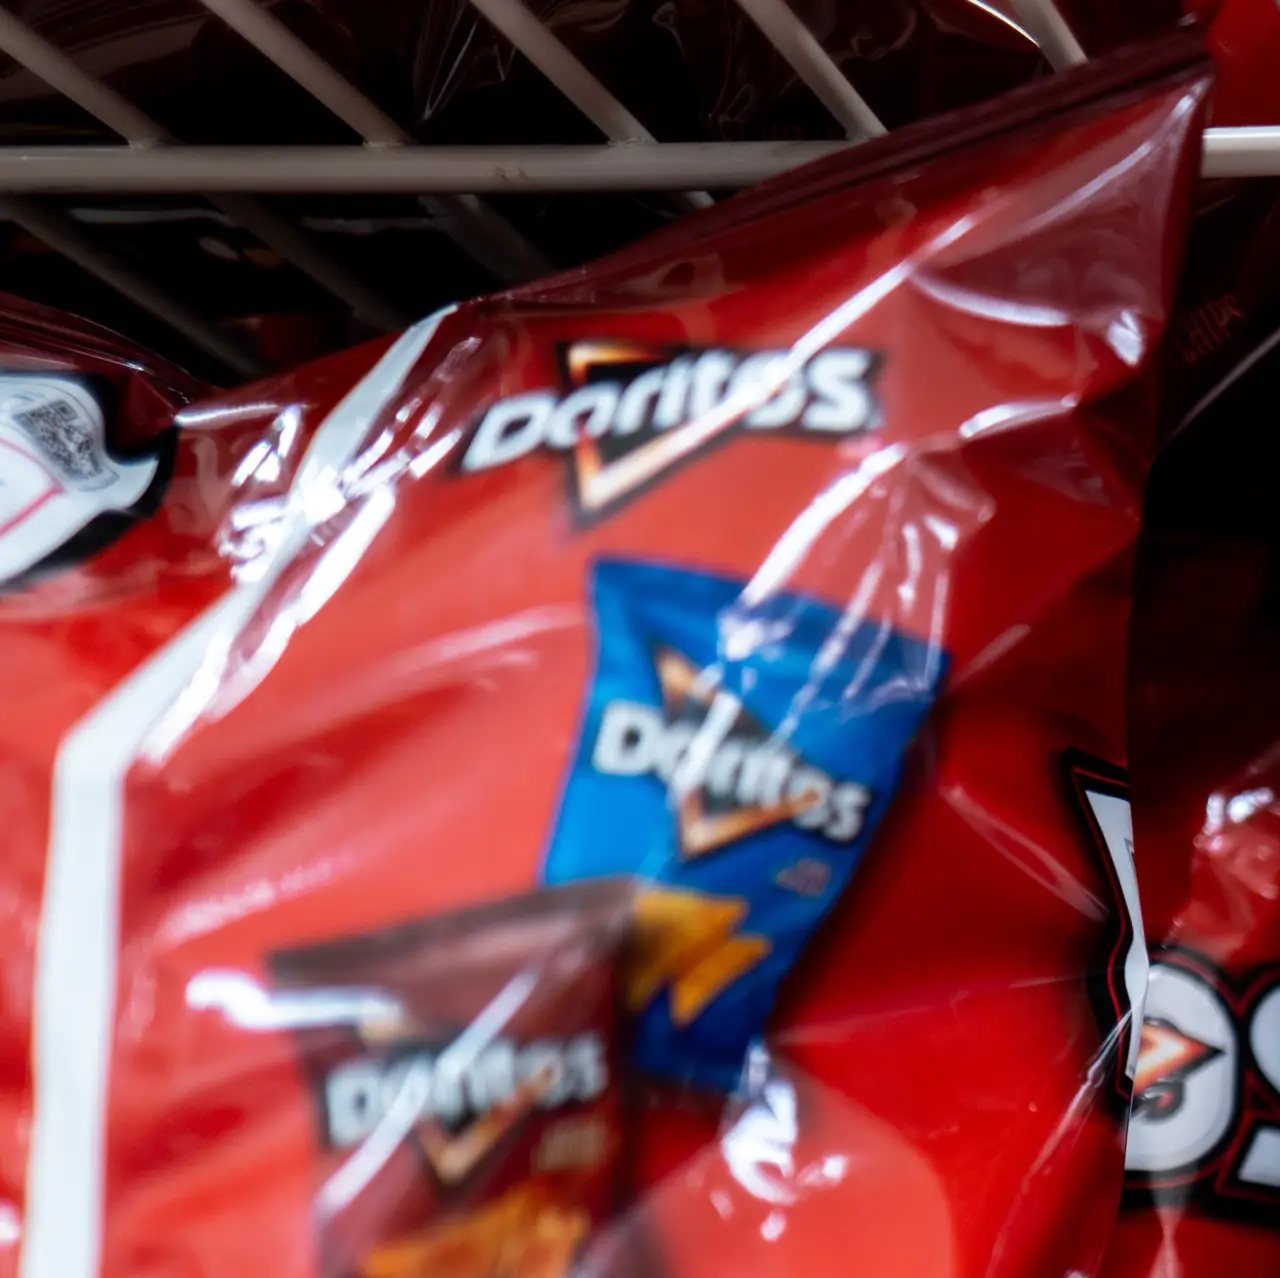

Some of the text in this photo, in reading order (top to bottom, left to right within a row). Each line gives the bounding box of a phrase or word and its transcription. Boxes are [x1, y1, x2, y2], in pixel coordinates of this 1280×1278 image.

[461, 347, 880, 474] Doritos
[590, 697, 872, 842] Doritos
[325, 1036, 608, 1147] Doritos
